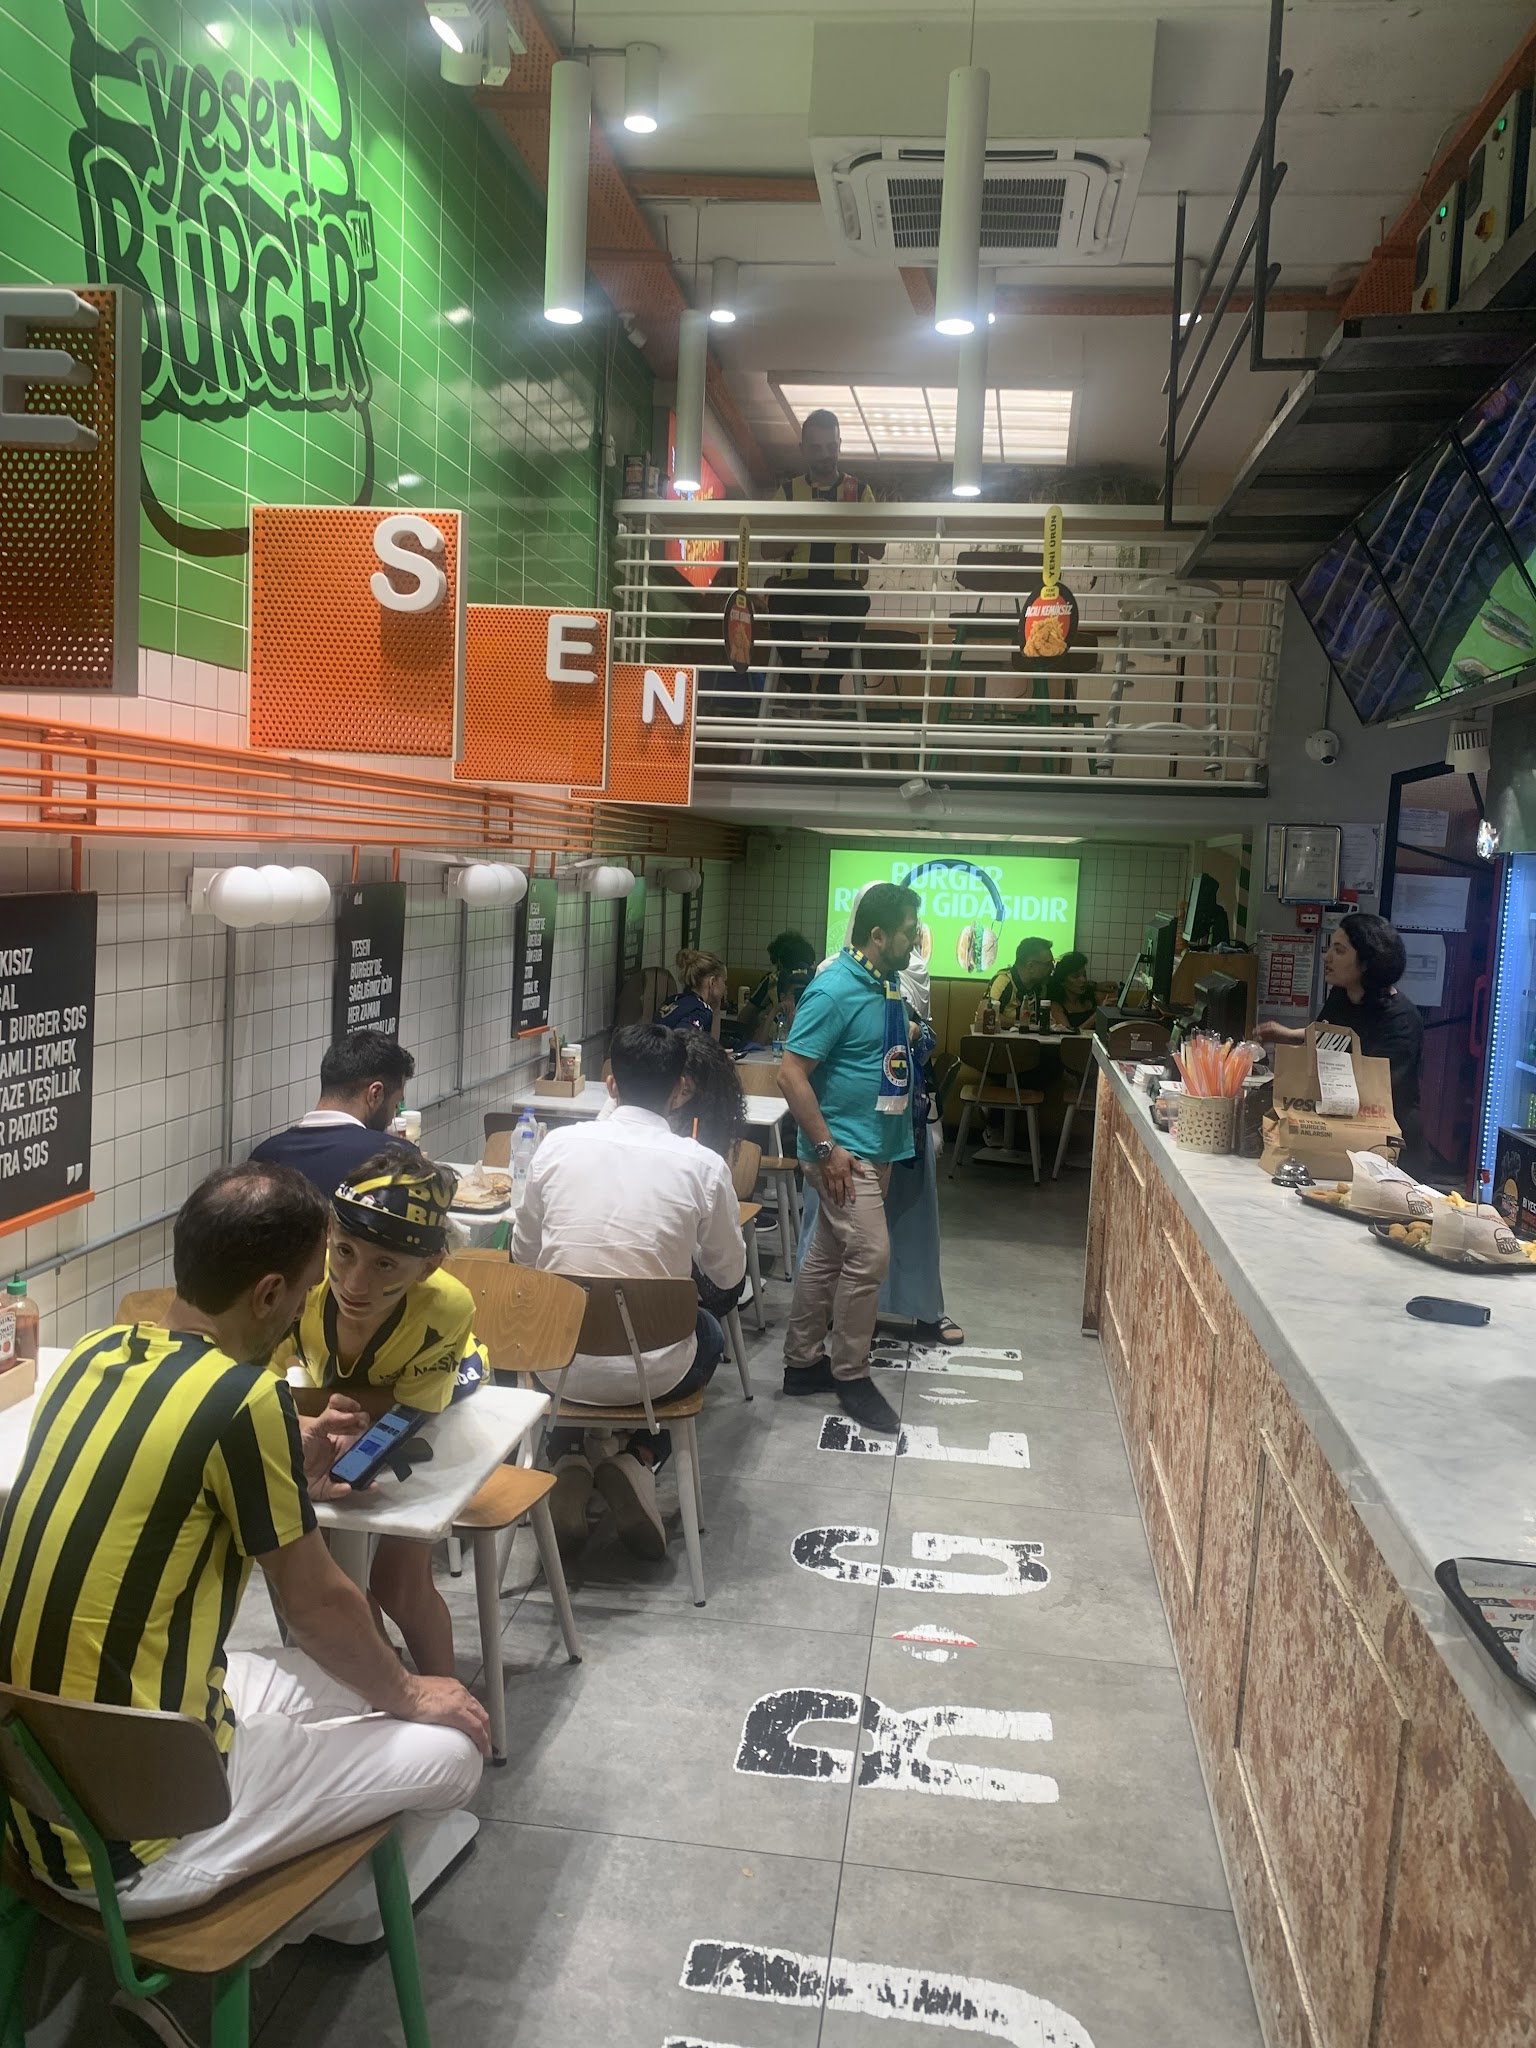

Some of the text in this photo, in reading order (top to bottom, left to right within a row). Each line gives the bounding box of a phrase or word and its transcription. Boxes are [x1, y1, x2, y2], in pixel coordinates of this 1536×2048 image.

[140, 54, 302, 214] yesen
[93, 155, 366, 400] BURGER
[891, 861, 1003, 892] BURGER
[9, 1010, 60, 1044] BURGER
[62, 1005, 87, 1033] SOS
[34, 1038, 77, 1072] EKMEK
[28, 1065, 81, 1106] YEŞİLLİK
[8, 1106, 58, 1145] PATATES
[23, 1140, 49, 1172] SOS
